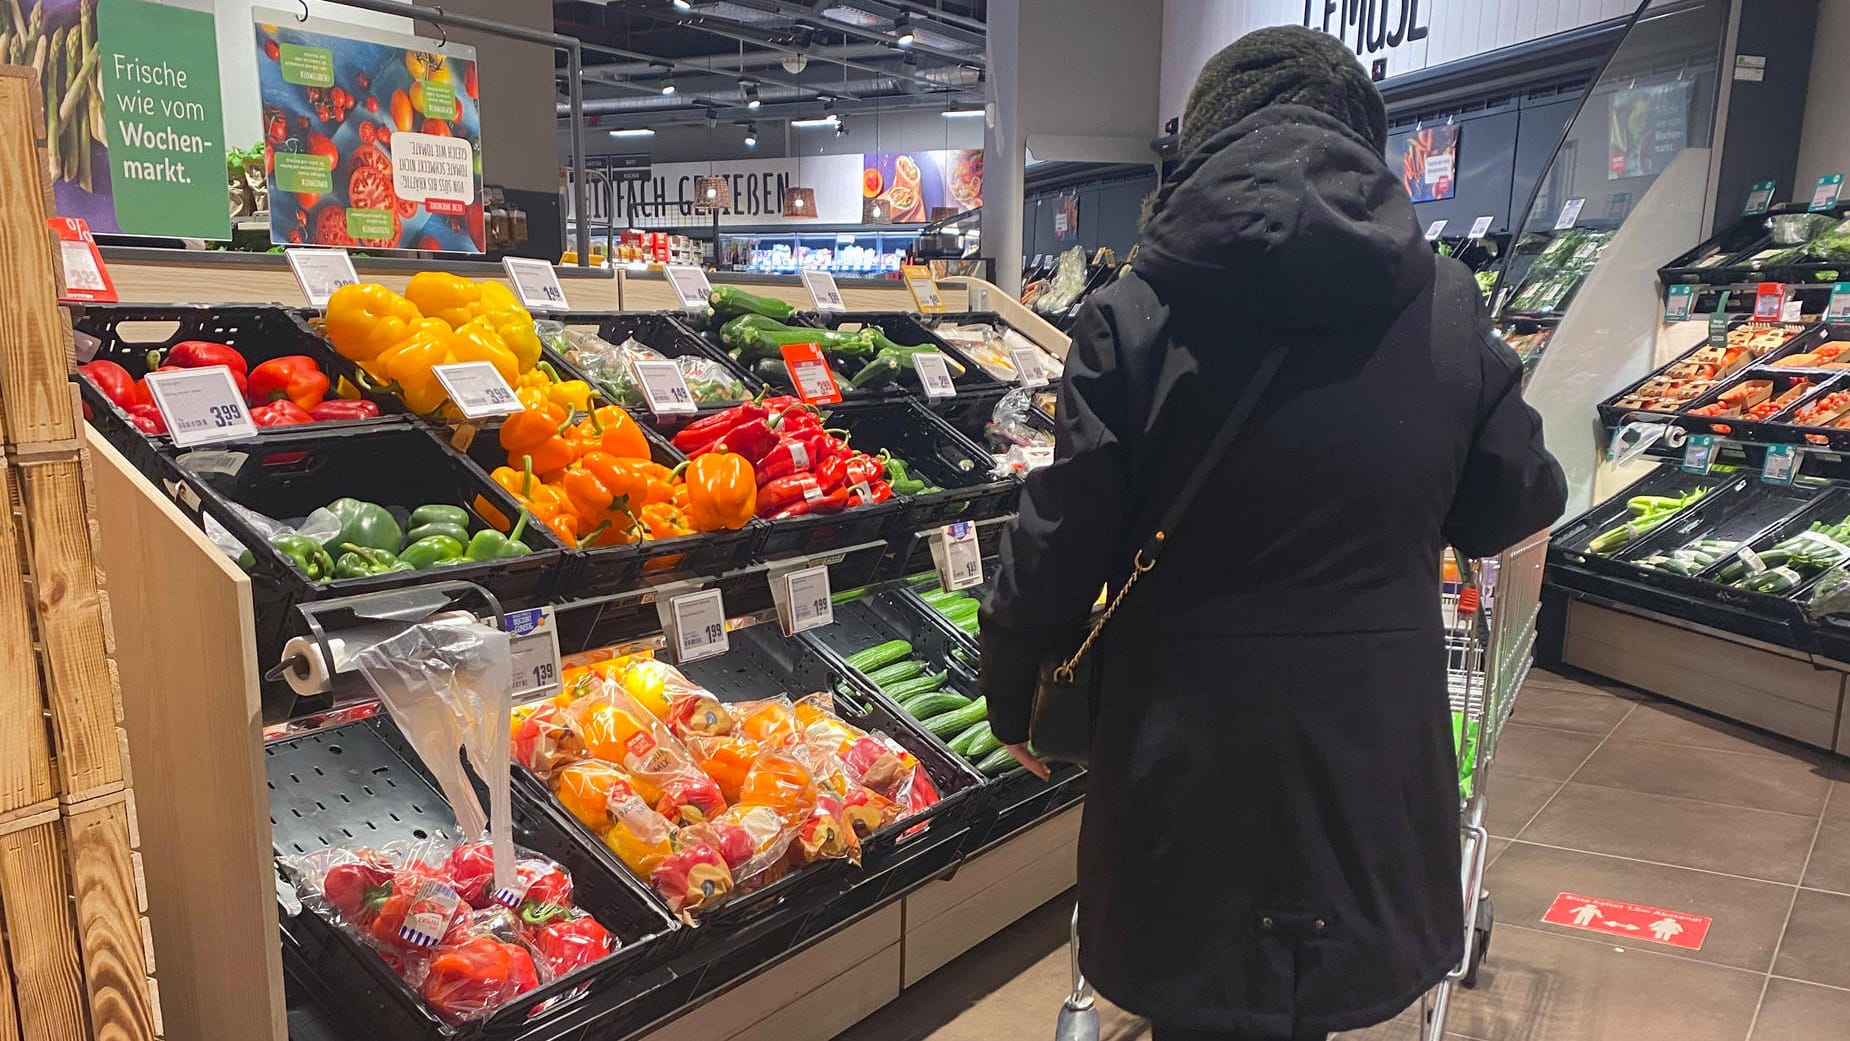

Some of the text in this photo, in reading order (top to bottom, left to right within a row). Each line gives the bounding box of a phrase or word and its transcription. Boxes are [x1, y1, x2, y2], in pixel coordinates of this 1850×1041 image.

[113, 53, 188, 89] Frische
[116, 89, 205, 121] wie vom
[118, 120, 213, 153] Wochen-
[123, 157, 191, 184] markt.
[578, 171, 790, 218] INFACH GEßEN
[485, 388, 511, 404] 3.99
[210, 403, 241, 428] 3.99
[813, 597, 829, 616] 1.99
[705, 623, 722, 644] 1.99
[533, 664, 553, 687] 1.39
